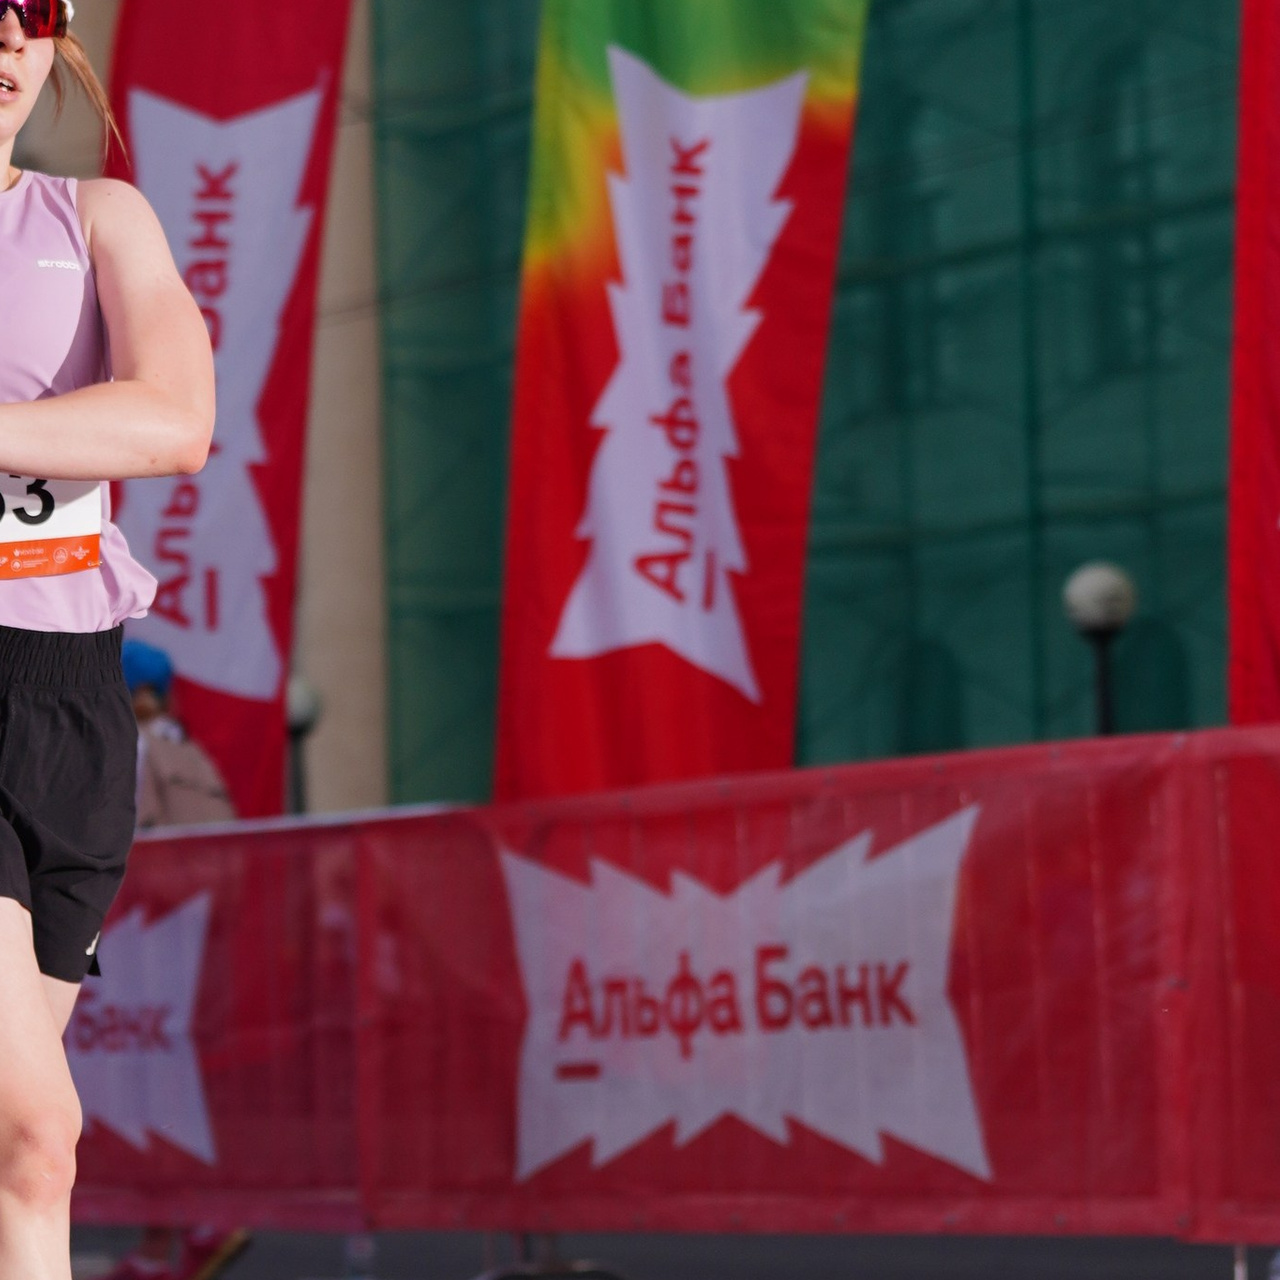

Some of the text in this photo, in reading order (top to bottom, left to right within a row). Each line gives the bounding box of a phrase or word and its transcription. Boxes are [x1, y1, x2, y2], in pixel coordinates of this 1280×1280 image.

[631, 137, 713, 606] Альфа Банк
[556, 943, 919, 1062] Альфа Банк
